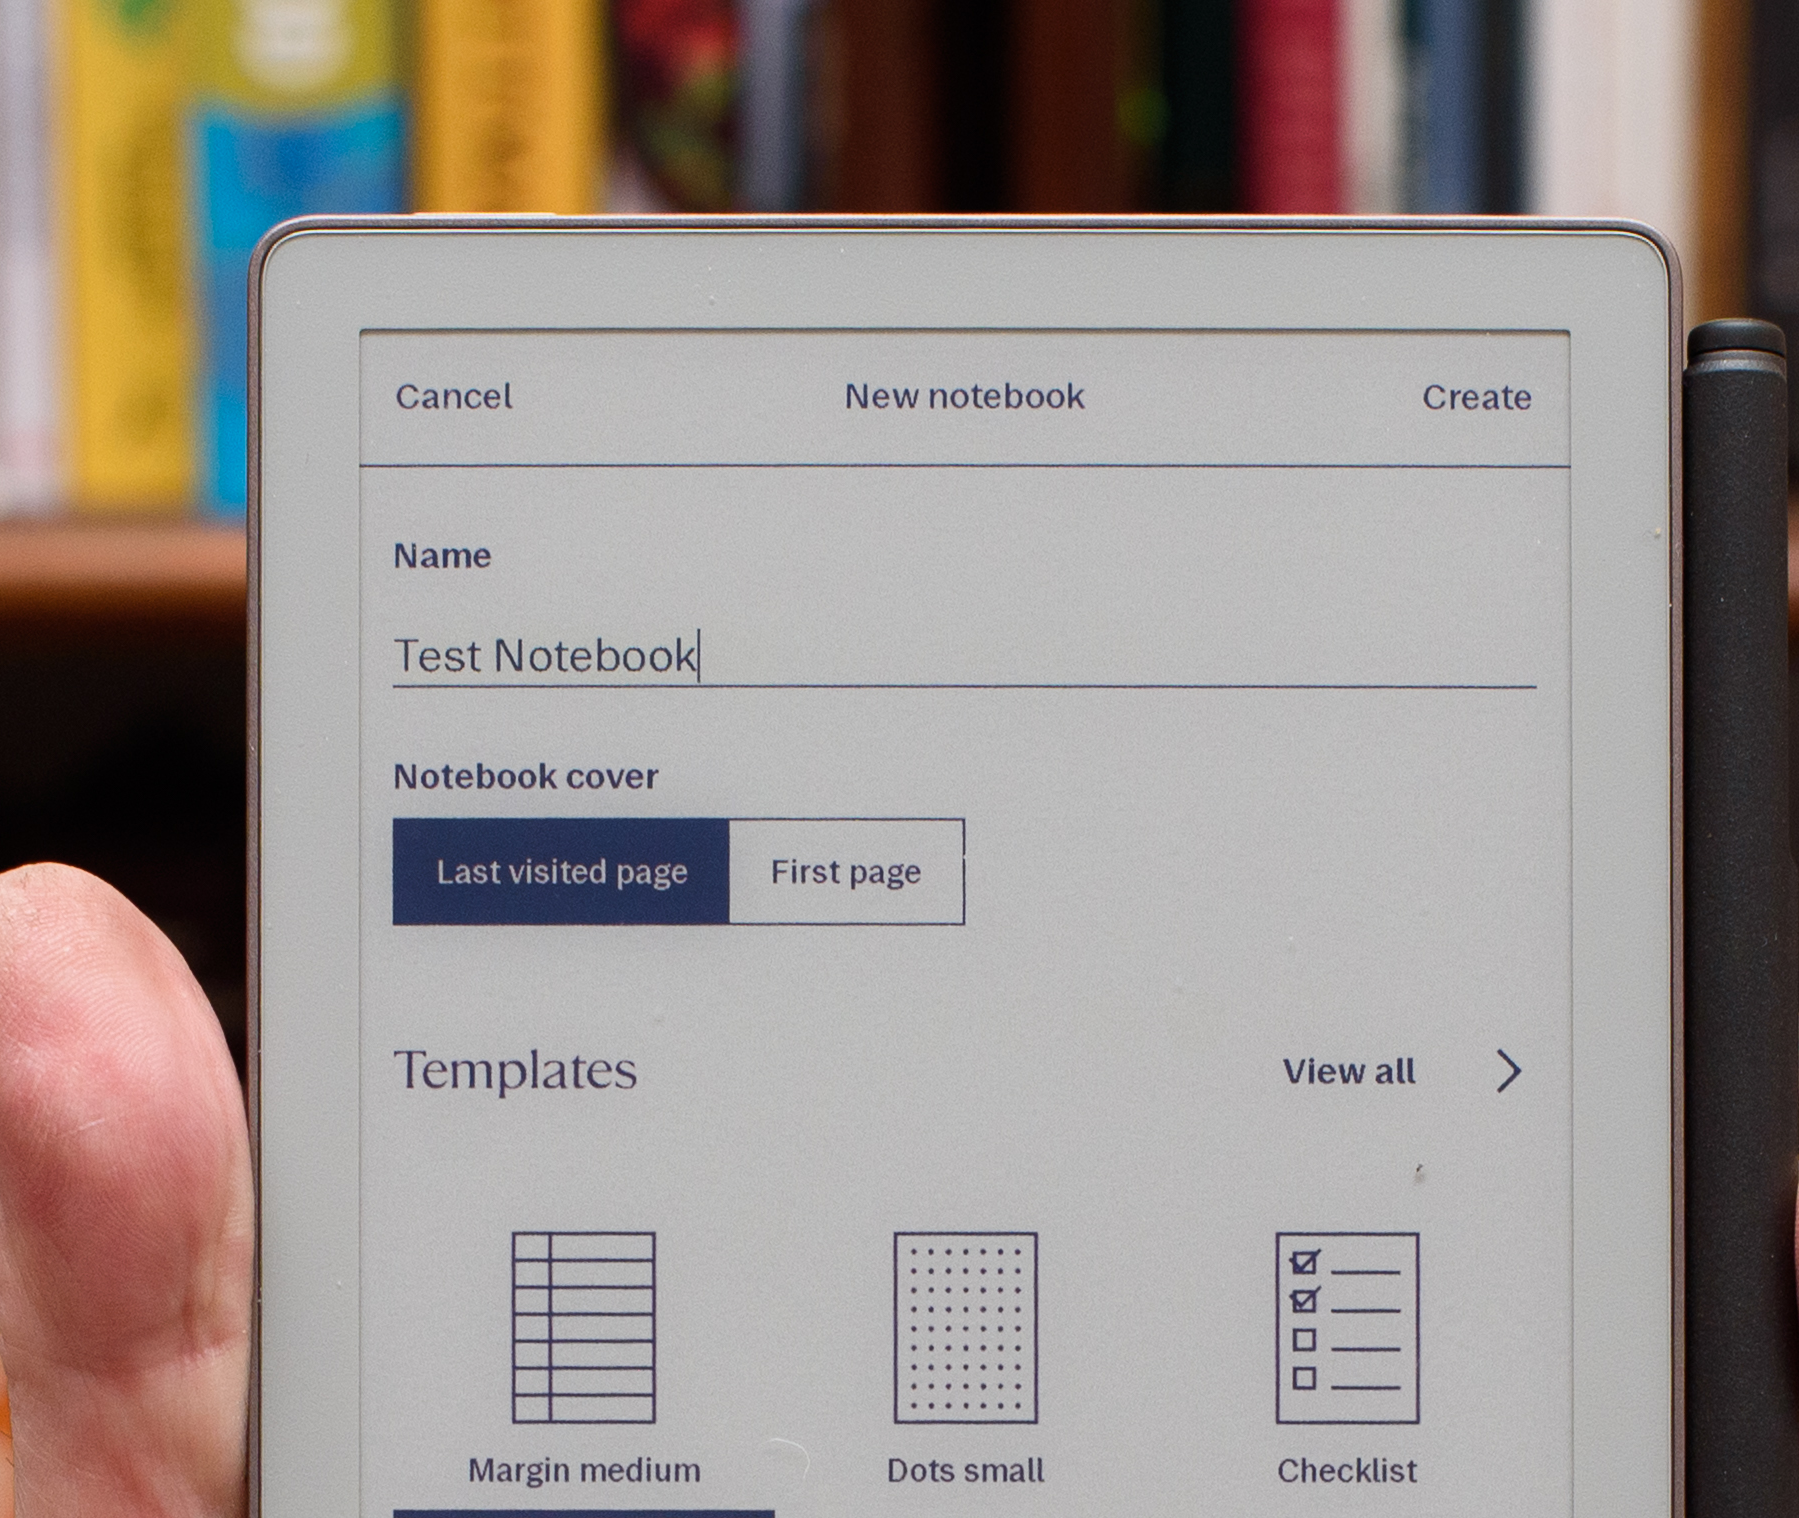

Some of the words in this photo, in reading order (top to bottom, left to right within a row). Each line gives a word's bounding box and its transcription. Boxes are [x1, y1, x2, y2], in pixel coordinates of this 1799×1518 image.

[396, 382, 515, 412] Cancel
[846, 383, 922, 411] New
[929, 382, 1087, 411] notebook
[1423, 384, 1534, 413] Create
[394, 542, 493, 571] Name
[395, 638, 483, 675] Test
[495, 637, 697, 675] Notebook
[394, 762, 559, 792] Notebook
[566, 768, 661, 792] cover
[437, 859, 503, 887] Last
[508, 858, 609, 887] visited
[617, 863, 690, 893] page
[772, 858, 842, 886] First
[850, 864, 923, 893] page
[393, 1049, 639, 1101] Templates
[1283, 1057, 1368, 1087] View
[1375, 1057, 1418, 1087] all
[469, 1457, 572, 1491] Margin
[580, 1456, 703, 1485] medium
[888, 1457, 958, 1485] Dots
[964, 1457, 1046, 1485] small
[1277, 1457, 1419, 1486] Checklist
